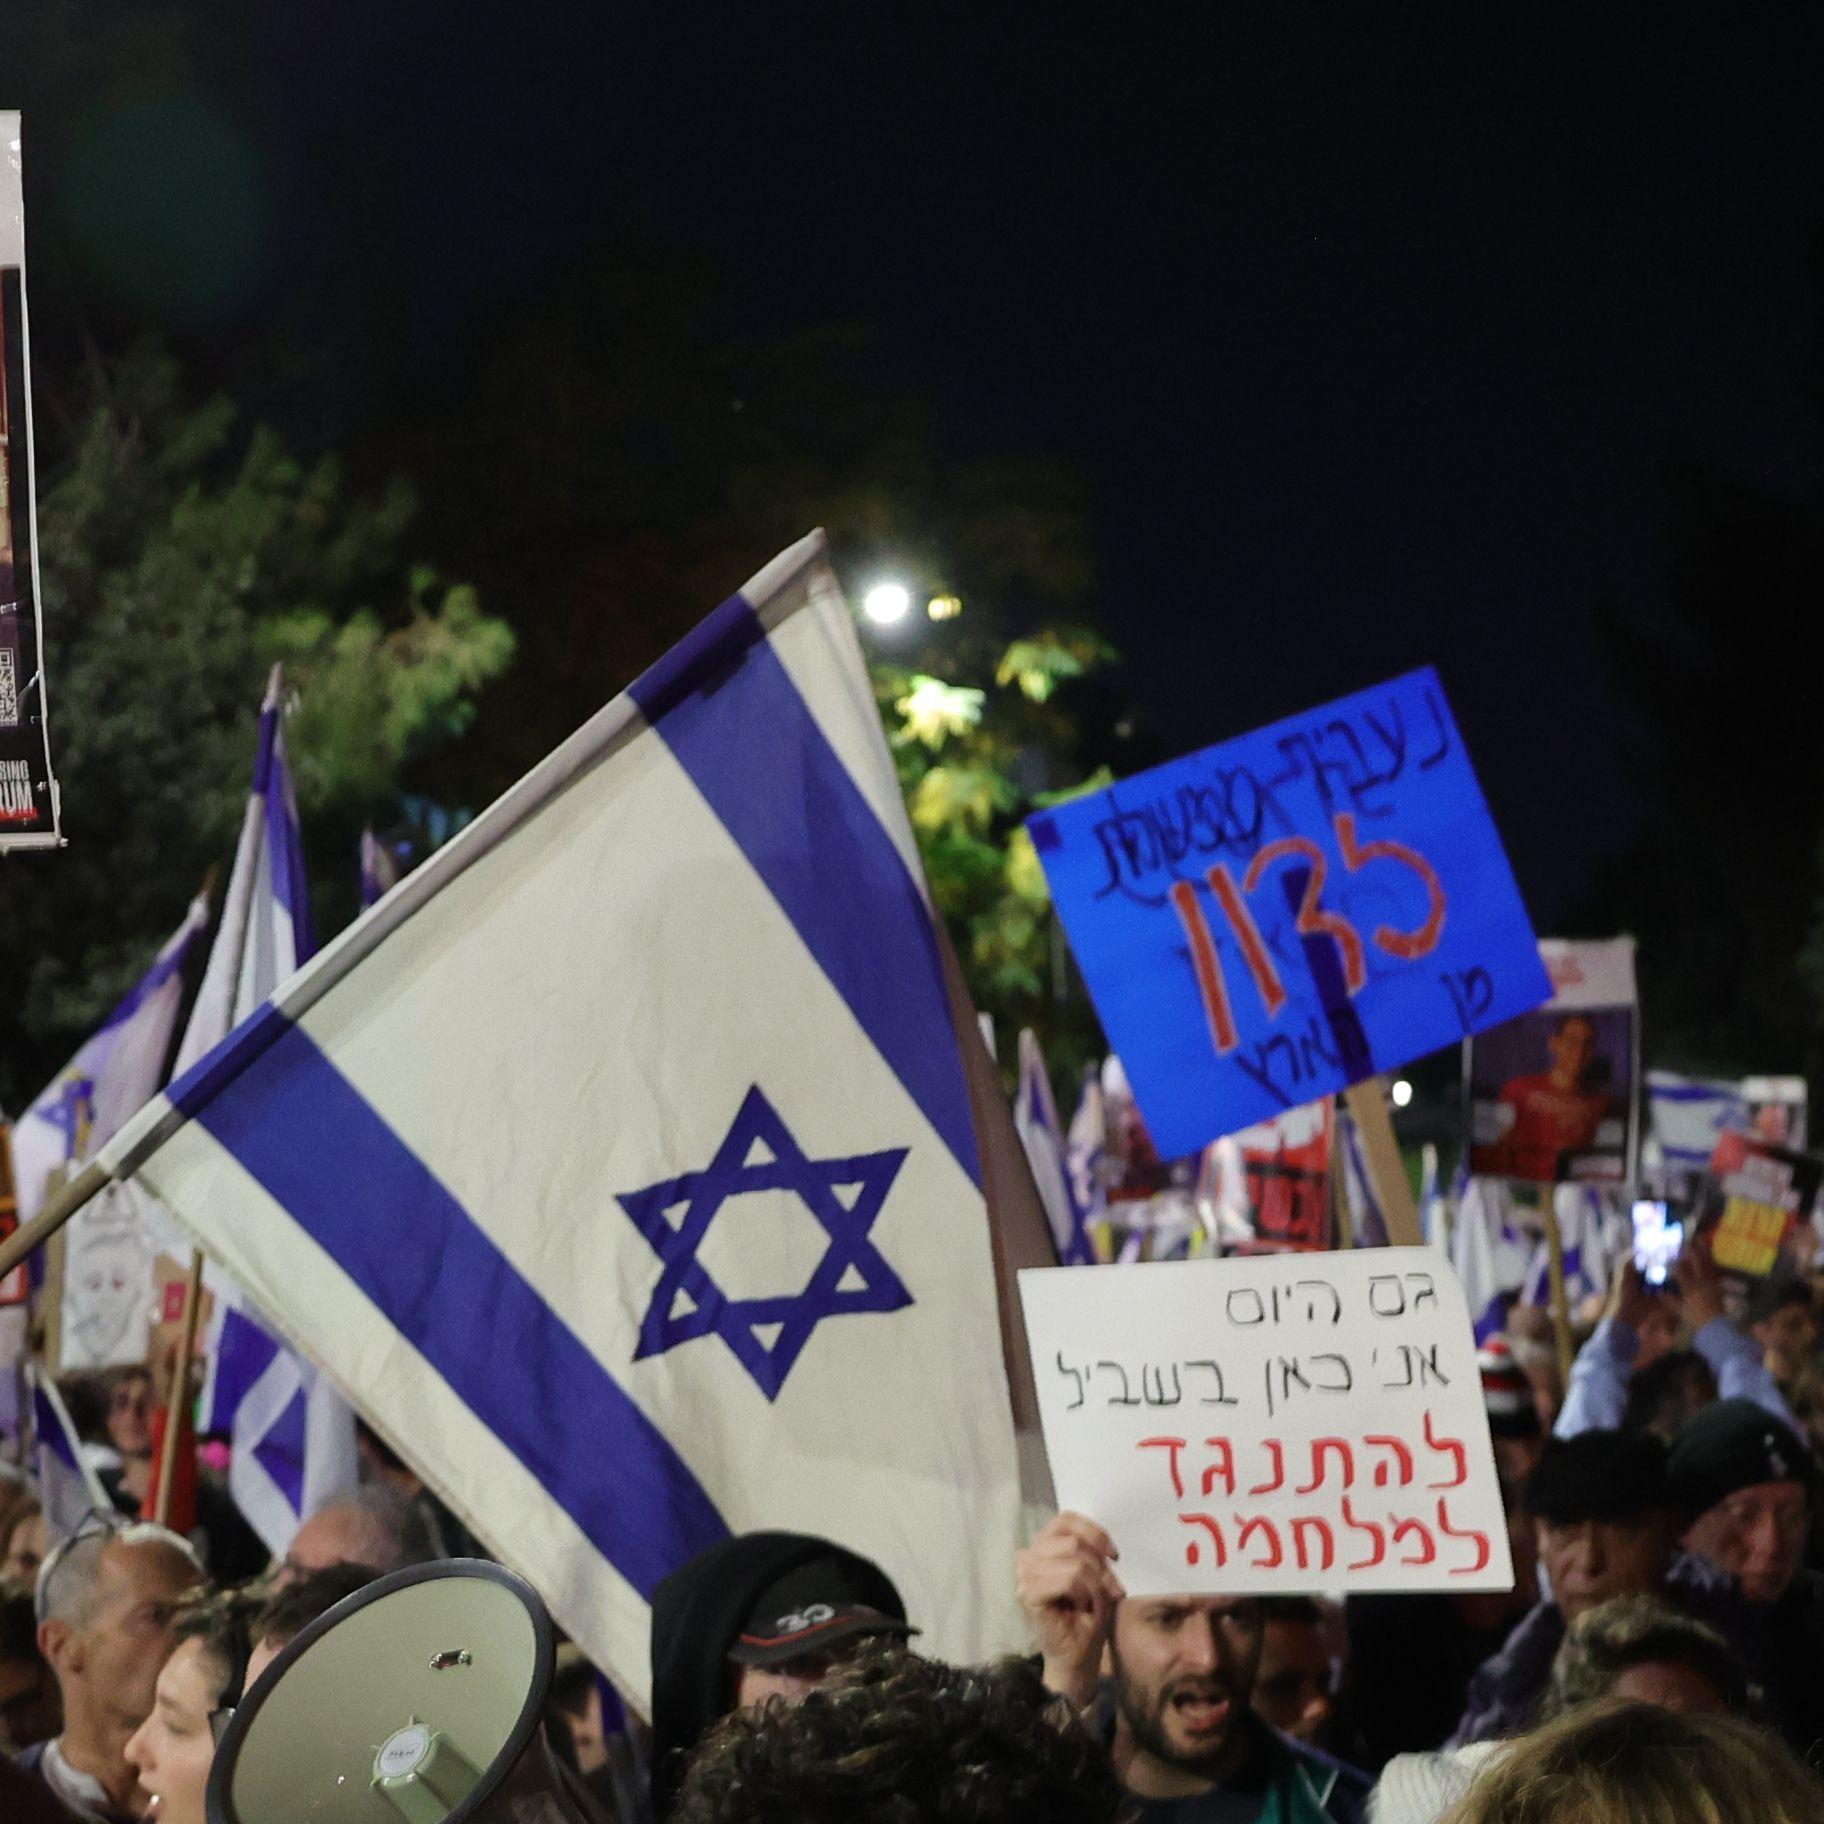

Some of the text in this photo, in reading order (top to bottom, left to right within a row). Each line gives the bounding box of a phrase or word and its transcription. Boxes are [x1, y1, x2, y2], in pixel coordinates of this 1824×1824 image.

[1226, 1272, 1440, 1326] גם היום
[1056, 1343, 1451, 1418] אני כאן בשביל
[1137, 1408, 1469, 1498] להתנגד
[1178, 1494, 1492, 1576] למלחמה
